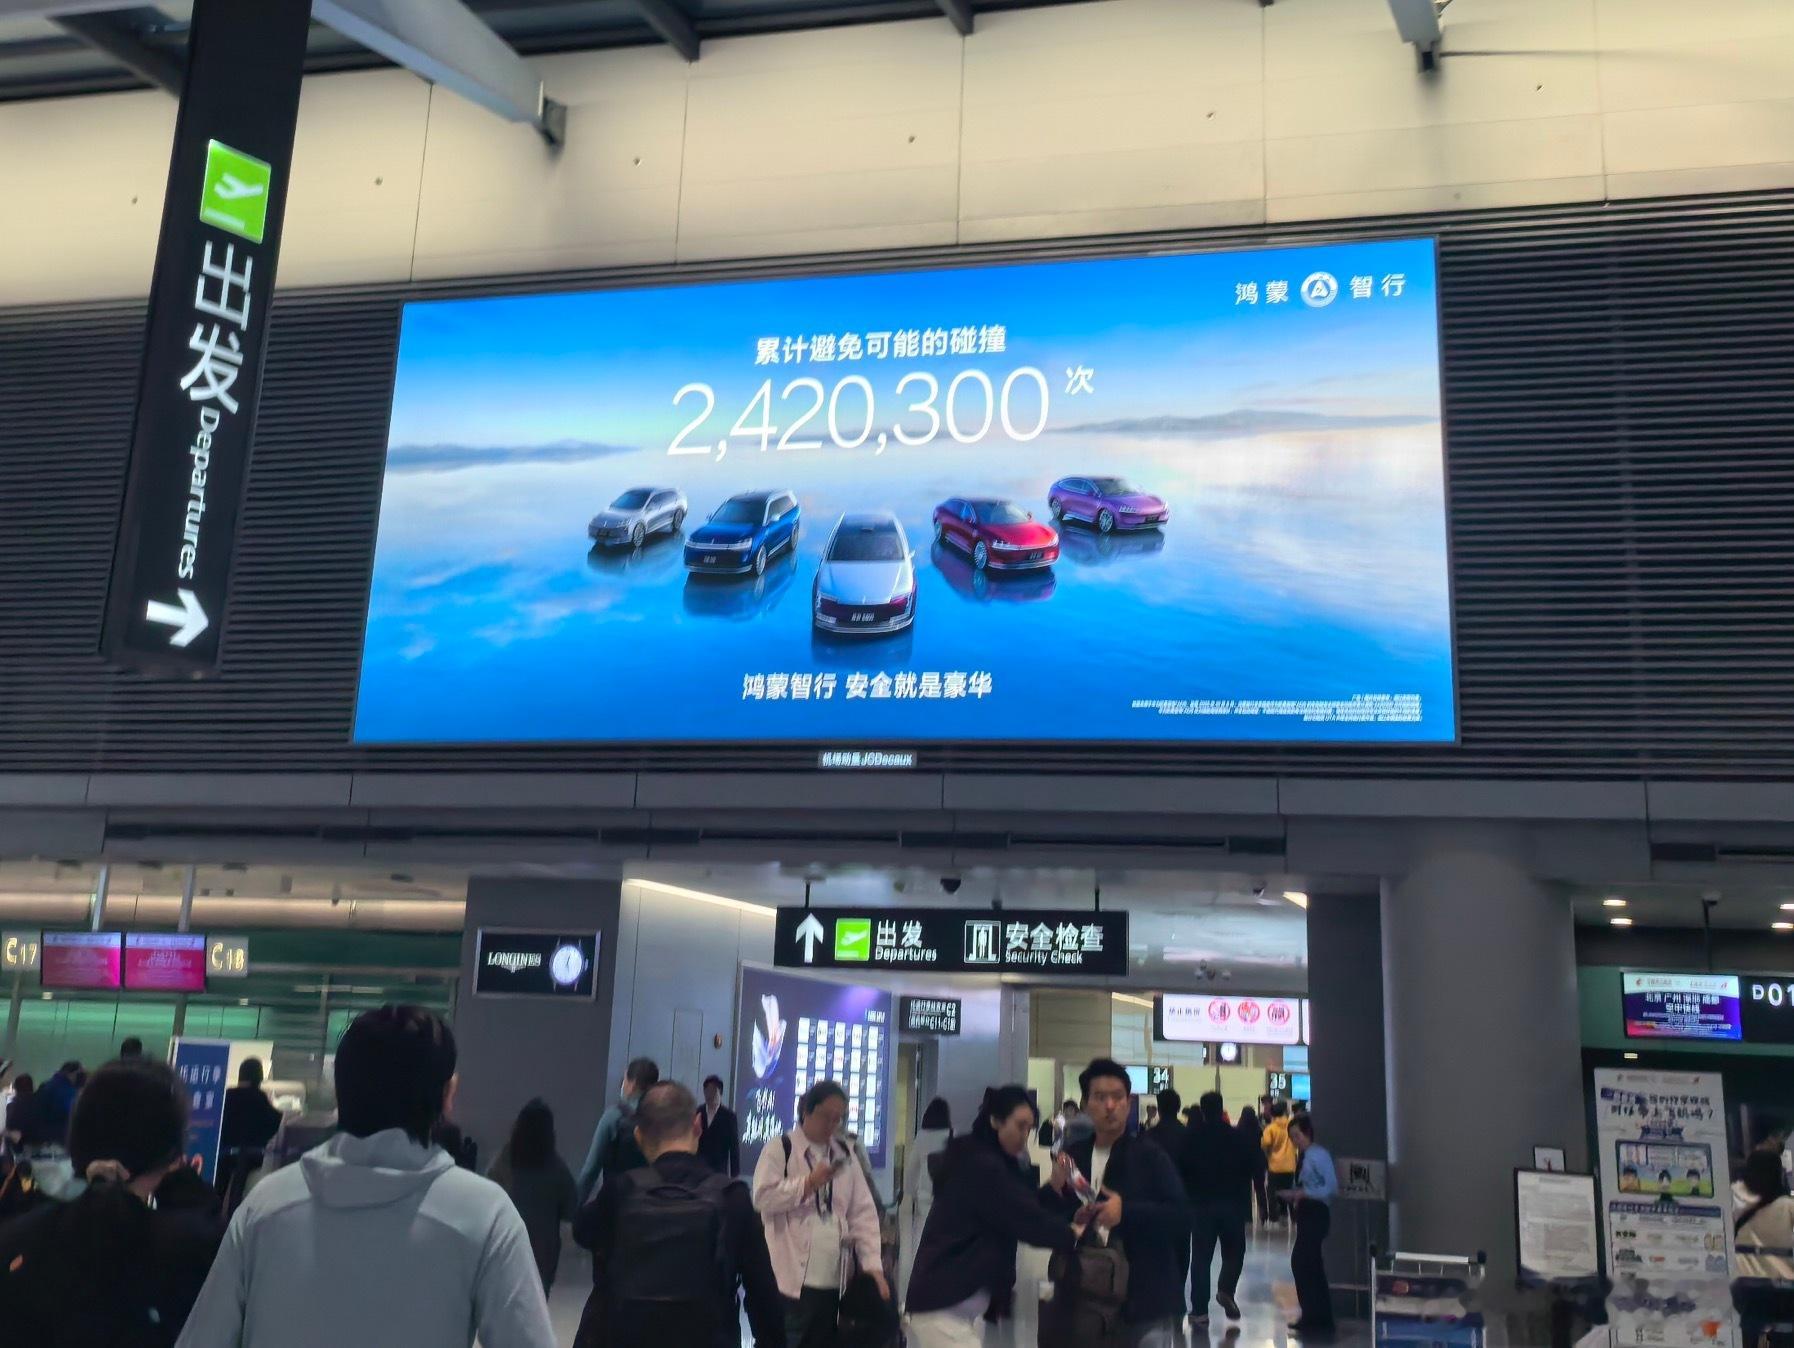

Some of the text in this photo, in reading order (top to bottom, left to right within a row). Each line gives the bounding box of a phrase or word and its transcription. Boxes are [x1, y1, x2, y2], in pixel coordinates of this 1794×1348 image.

[1234, 272, 1406, 306] 鸿蒙 智行
[180, 240, 254, 415] 出发
[755, 324, 1007, 366] 累计避免可能的碰撞
[667, 365, 1095, 462] 2,420,300 次
[177, 406, 220, 579] Departures
[742, 670, 993, 701] 鸿蒙智行 安全就是豪华
[876, 919, 924, 949] 出发
[1005, 921, 1104, 952] 安全检查
[5, 937, 38, 966] C17
[211, 942, 245, 971] C18
[487, 951, 542, 967] LONGINES
[874, 947, 937, 962] Departures
[1005, 949, 1083, 966] Security Check
